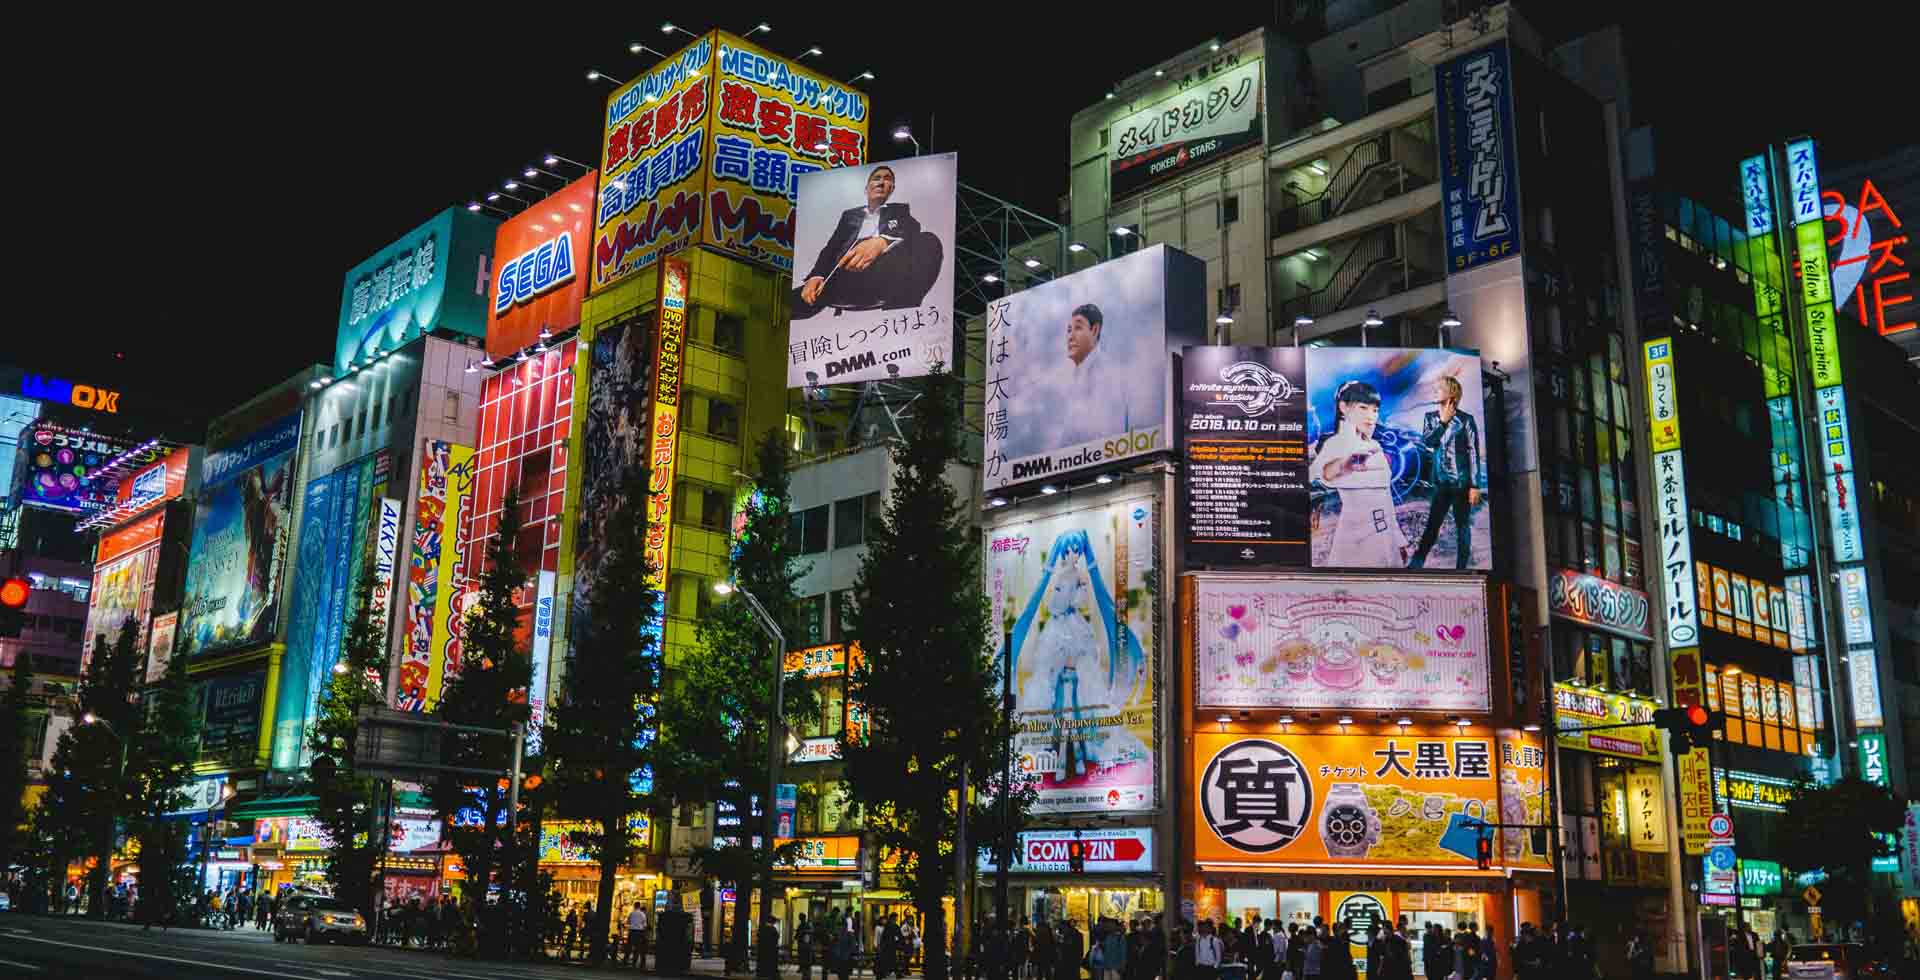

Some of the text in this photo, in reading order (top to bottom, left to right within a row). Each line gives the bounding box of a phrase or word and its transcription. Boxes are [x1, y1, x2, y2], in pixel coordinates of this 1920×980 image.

[604, 76, 708, 175] 激安販売
[719, 80, 863, 168] 激安販売
[1118, 77, 1252, 158] メイドカジノ
[599, 128, 703, 228] 高額買取
[1151, 140, 1216, 175] POKER STARS
[496, 231, 575, 315] SEGA
[1804, 256, 1820, 299] Yellow
[664, 311, 682, 322] DVD
[789, 305, 947, 365] 冒険しつづけよう。
[664, 342, 677, 352] CD
[825, 346, 911, 379] DMM.com
[1651, 347, 1666, 358] 3F
[1811, 310, 1829, 380] Submarine
[659, 361, 678, 373] アニメ
[986, 301, 1012, 488] 次は太陽か。
[1190, 420, 1258, 431] 2018.10.10
[1279, 422, 1303, 431] sale
[1012, 425, 1160, 480] DMM.make solar
[1661, 454, 1692, 621] 喫茶室ルノアール
[537, 596, 553, 638] SEGA
[1552, 575, 1649, 632] メイドカジノ
[1319, 765, 1368, 777] チケット
[1374, 741, 1491, 779] 大黒屋
[1212, 758, 1303, 840] 質
[1640, 788, 1655, 841] ルノアール
[1714, 820, 1727, 830] 40
[1090, 840, 1115, 861] ZIN
[1744, 868, 1782, 887] リバティー
